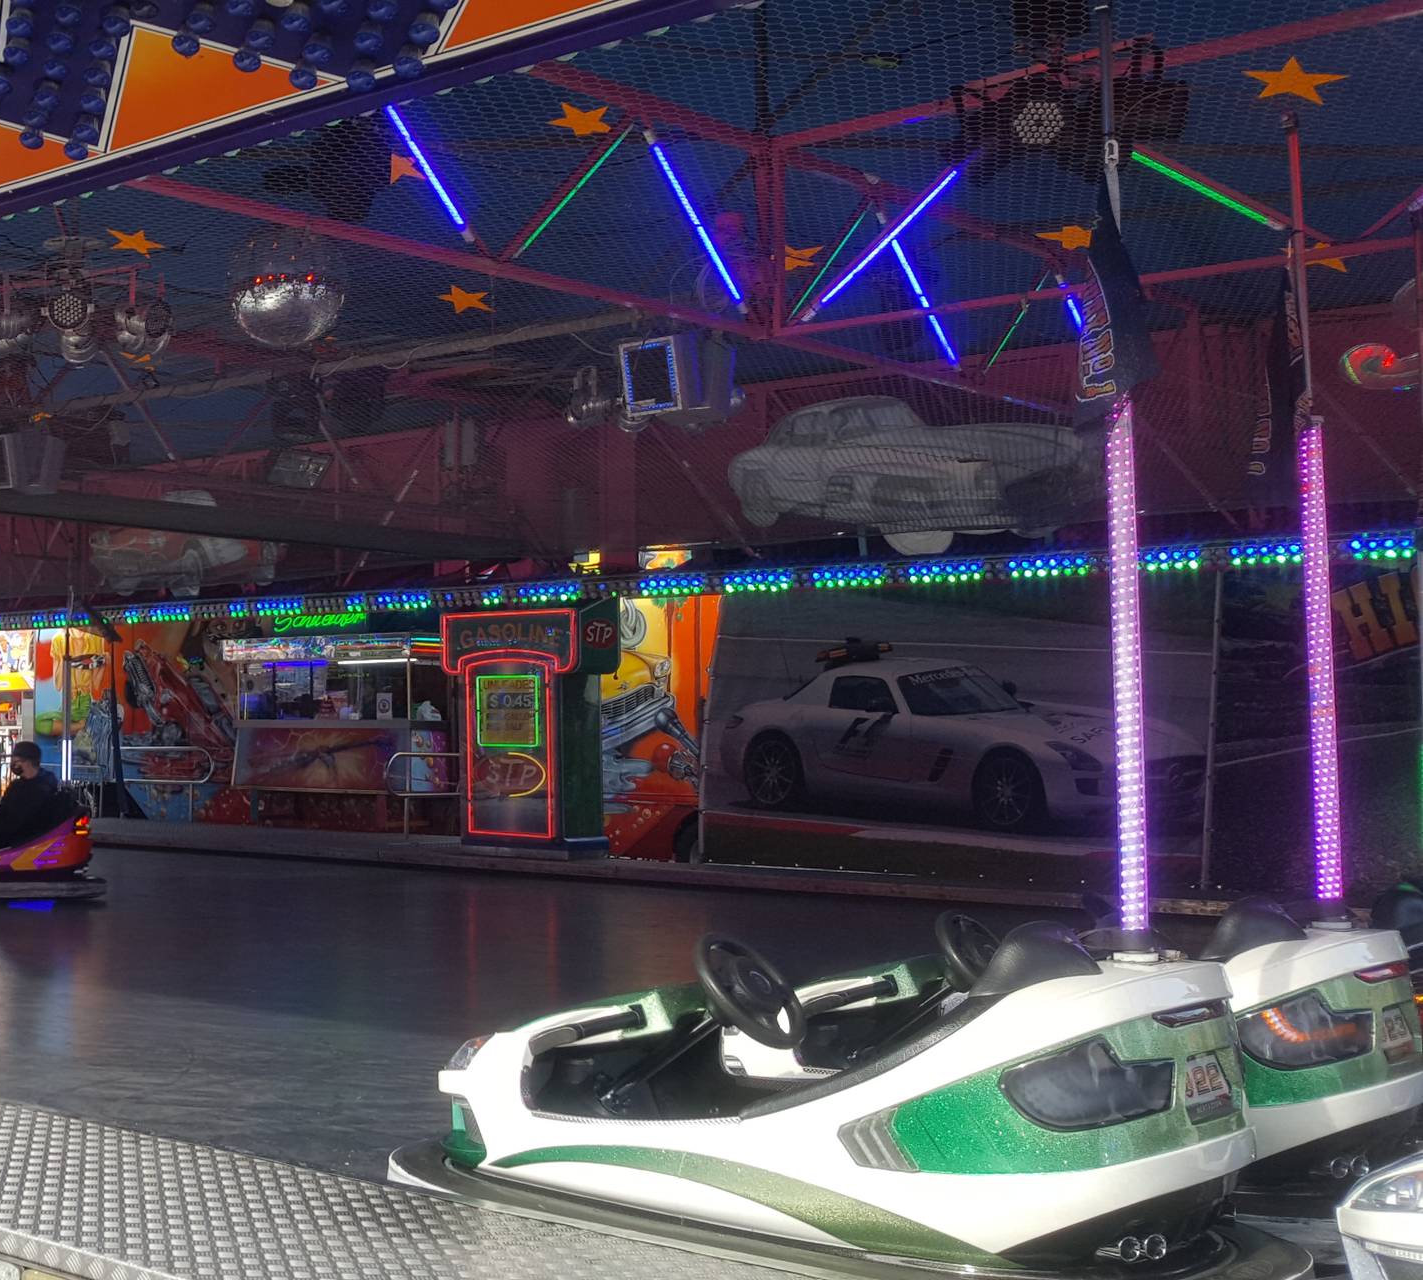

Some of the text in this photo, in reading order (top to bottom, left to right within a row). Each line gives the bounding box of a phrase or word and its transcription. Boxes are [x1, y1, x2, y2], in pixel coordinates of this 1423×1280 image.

[459, 622, 563, 649] GASOLINE
[585, 621, 613, 644] STP
[503, 694, 533, 708] 0.45
[485, 758, 538, 787] STP
